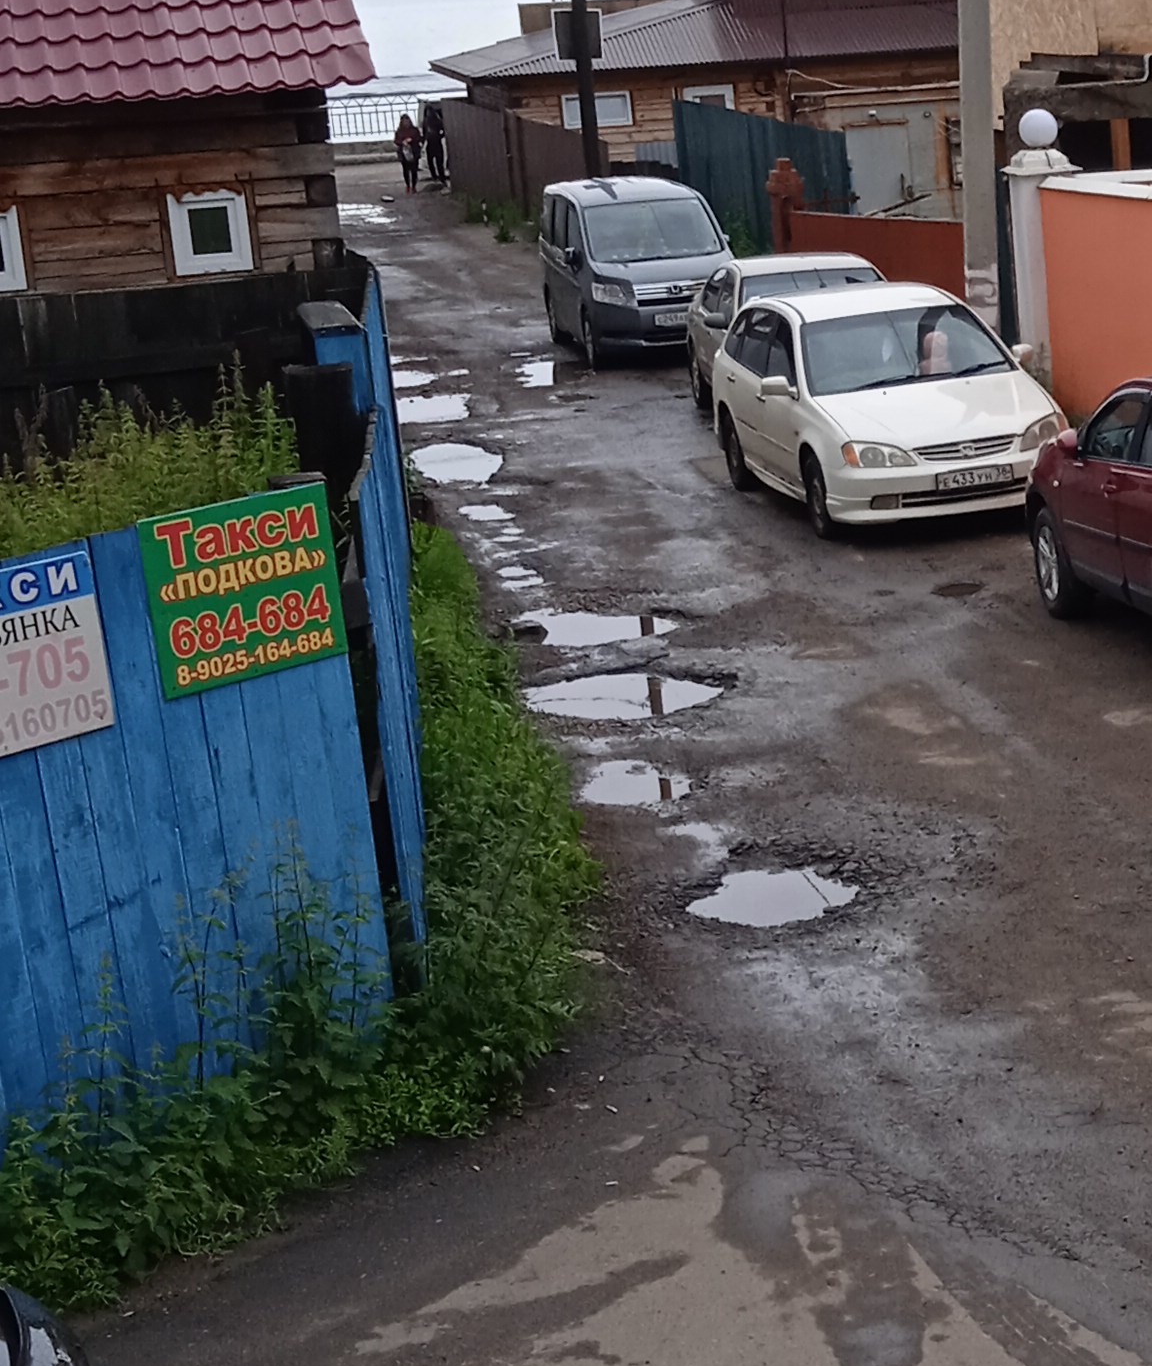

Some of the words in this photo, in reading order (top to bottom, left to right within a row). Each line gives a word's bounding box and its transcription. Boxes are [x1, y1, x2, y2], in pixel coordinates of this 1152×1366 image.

[154, 503, 319, 569] Такси
[0, 560, 79, 609] СИ
[160, 547, 326, 602] «ПОДКОВА»
[0, 604, 80, 647] ЯНКА
[170, 584, 331, 658] 684-684
[176, 627, 335, 686] 8-9025-164-684
[0, 688, 108, 743] 160705
